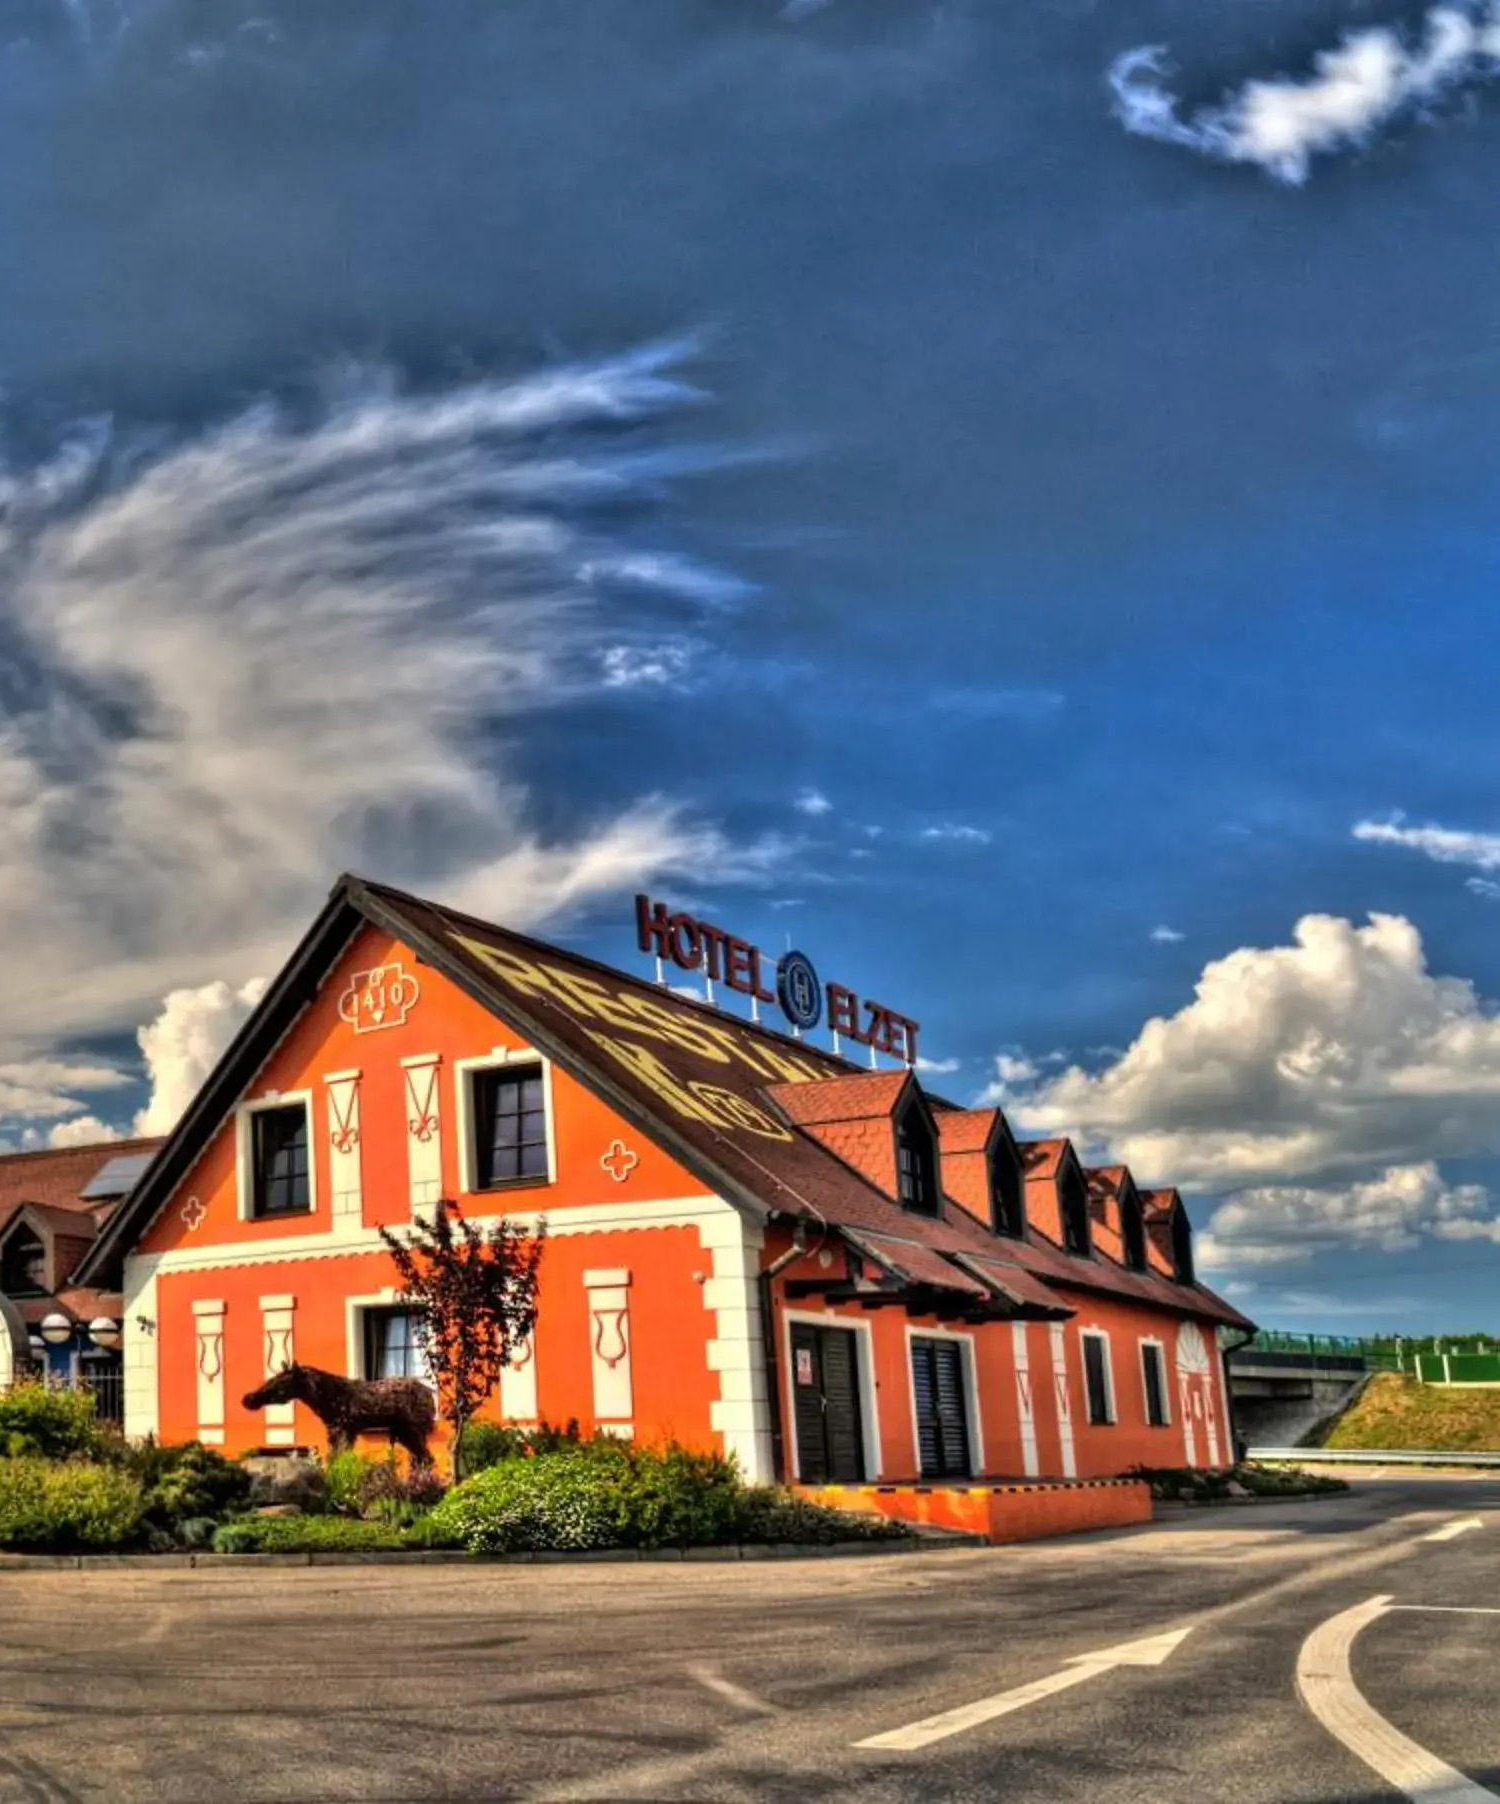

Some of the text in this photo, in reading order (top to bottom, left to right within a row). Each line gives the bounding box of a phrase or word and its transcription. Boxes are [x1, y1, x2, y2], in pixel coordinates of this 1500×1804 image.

[635, 894, 775, 1003] HOTEL
[352, 981, 404, 1016] 1410
[825, 981, 919, 1064] ELZET
